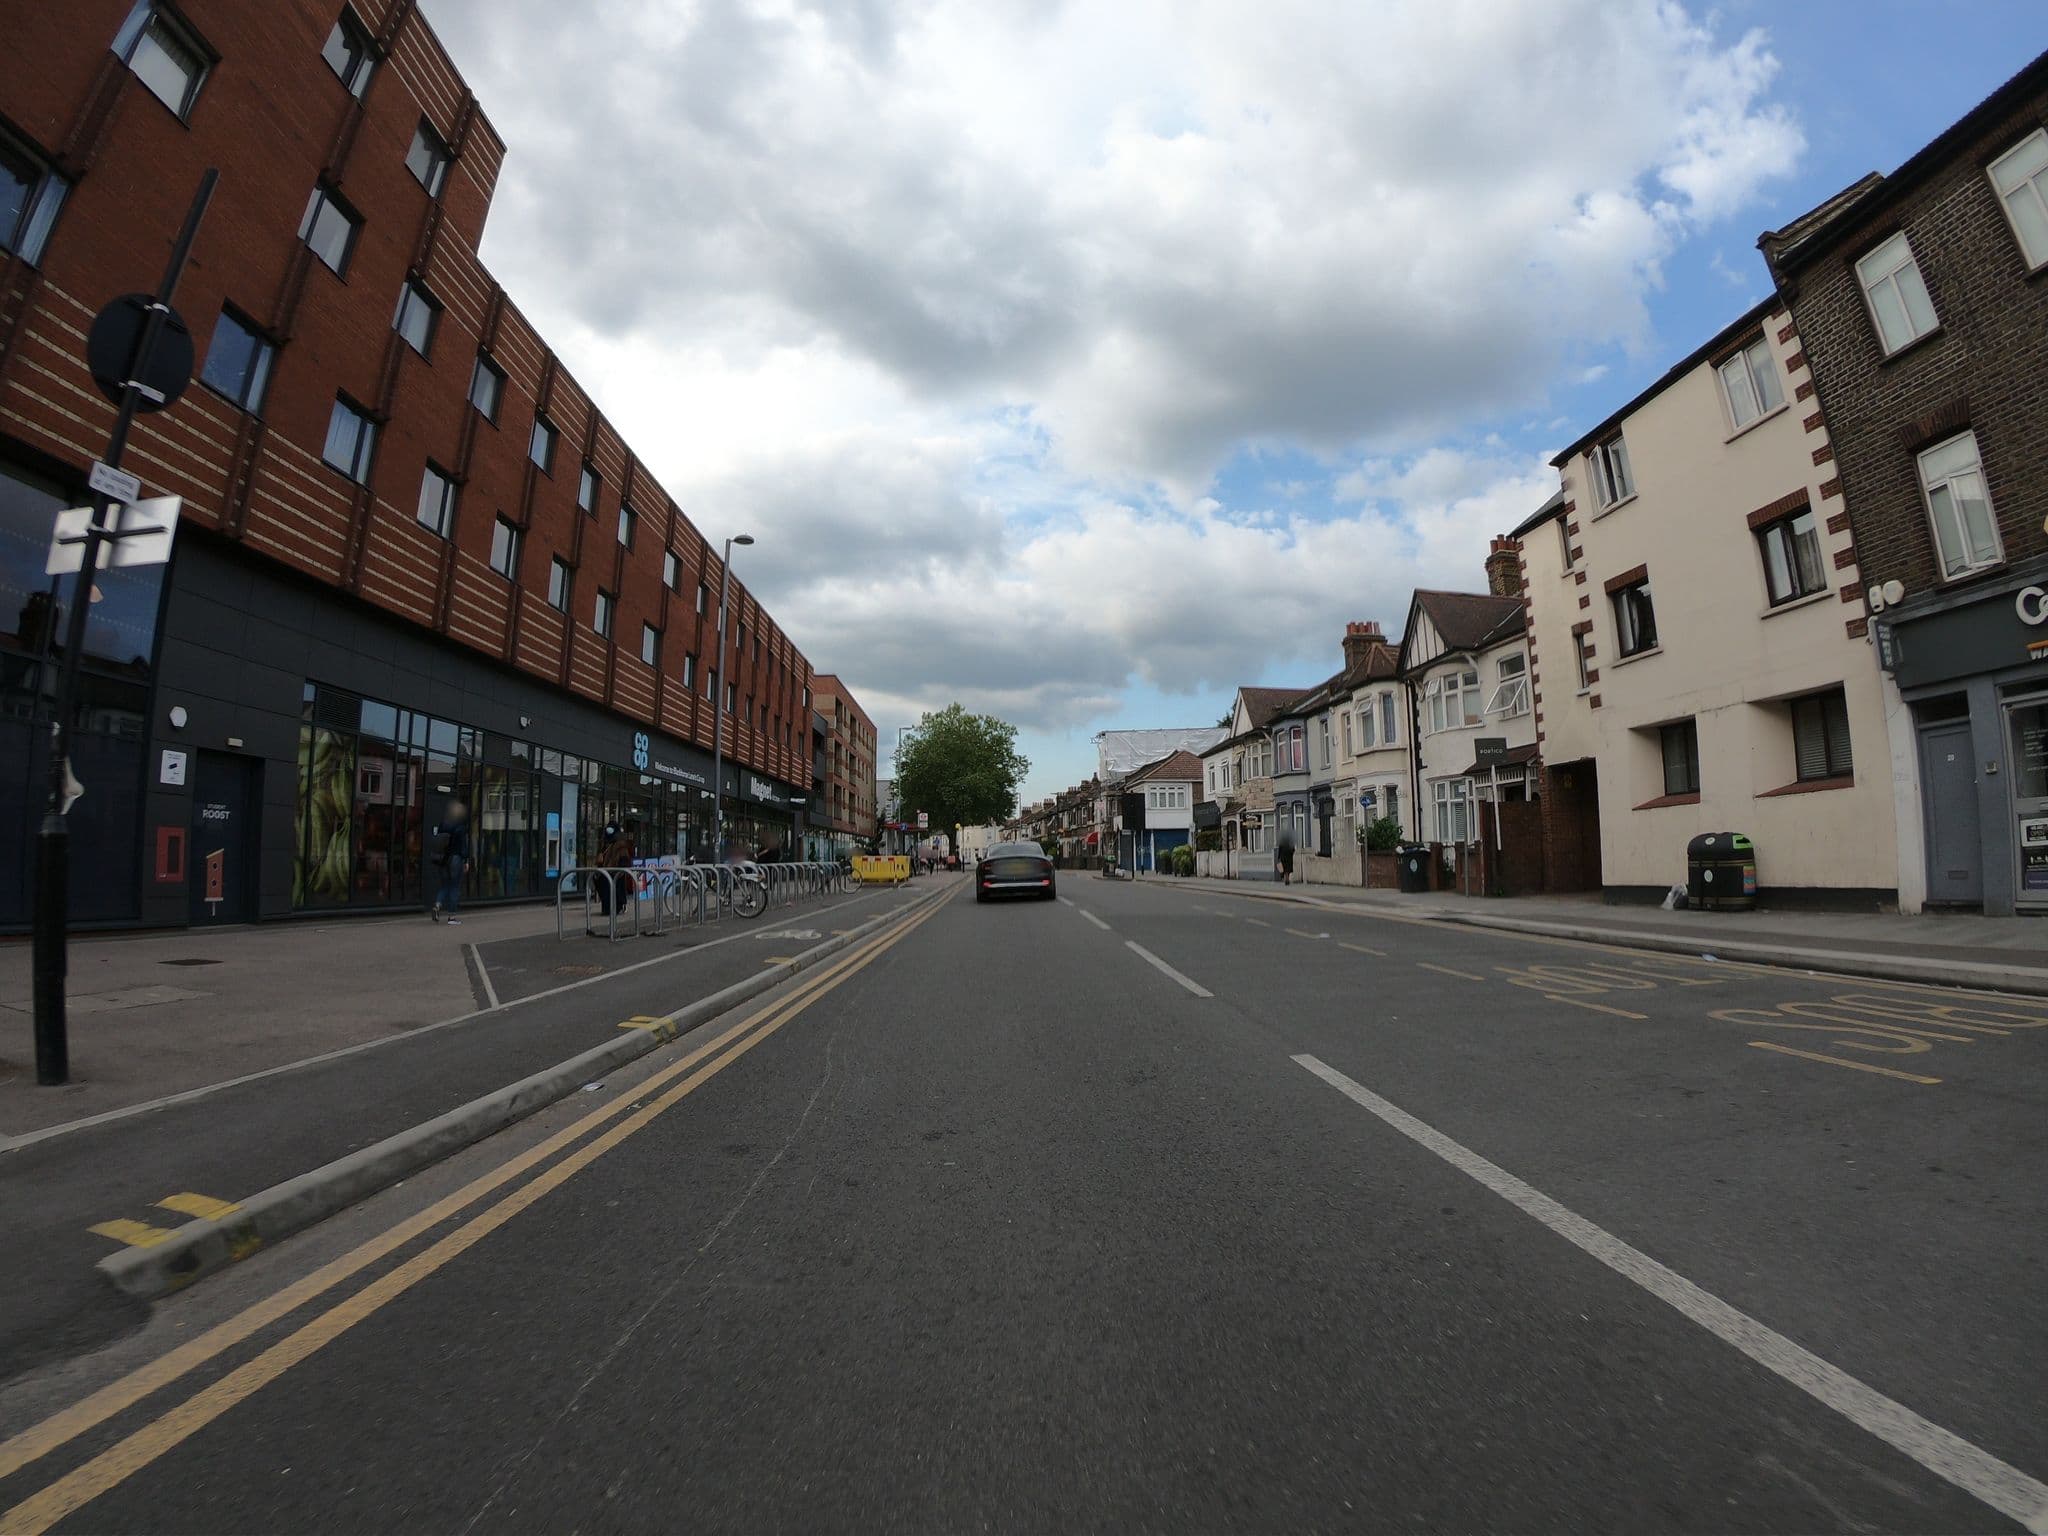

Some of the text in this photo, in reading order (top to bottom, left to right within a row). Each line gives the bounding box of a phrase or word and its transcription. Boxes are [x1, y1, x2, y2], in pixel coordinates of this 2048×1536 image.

[750, 776, 773, 801] Magnet
[202, 809, 230, 820] ROOST
[1707, 993, 2048, 1054] BUS
